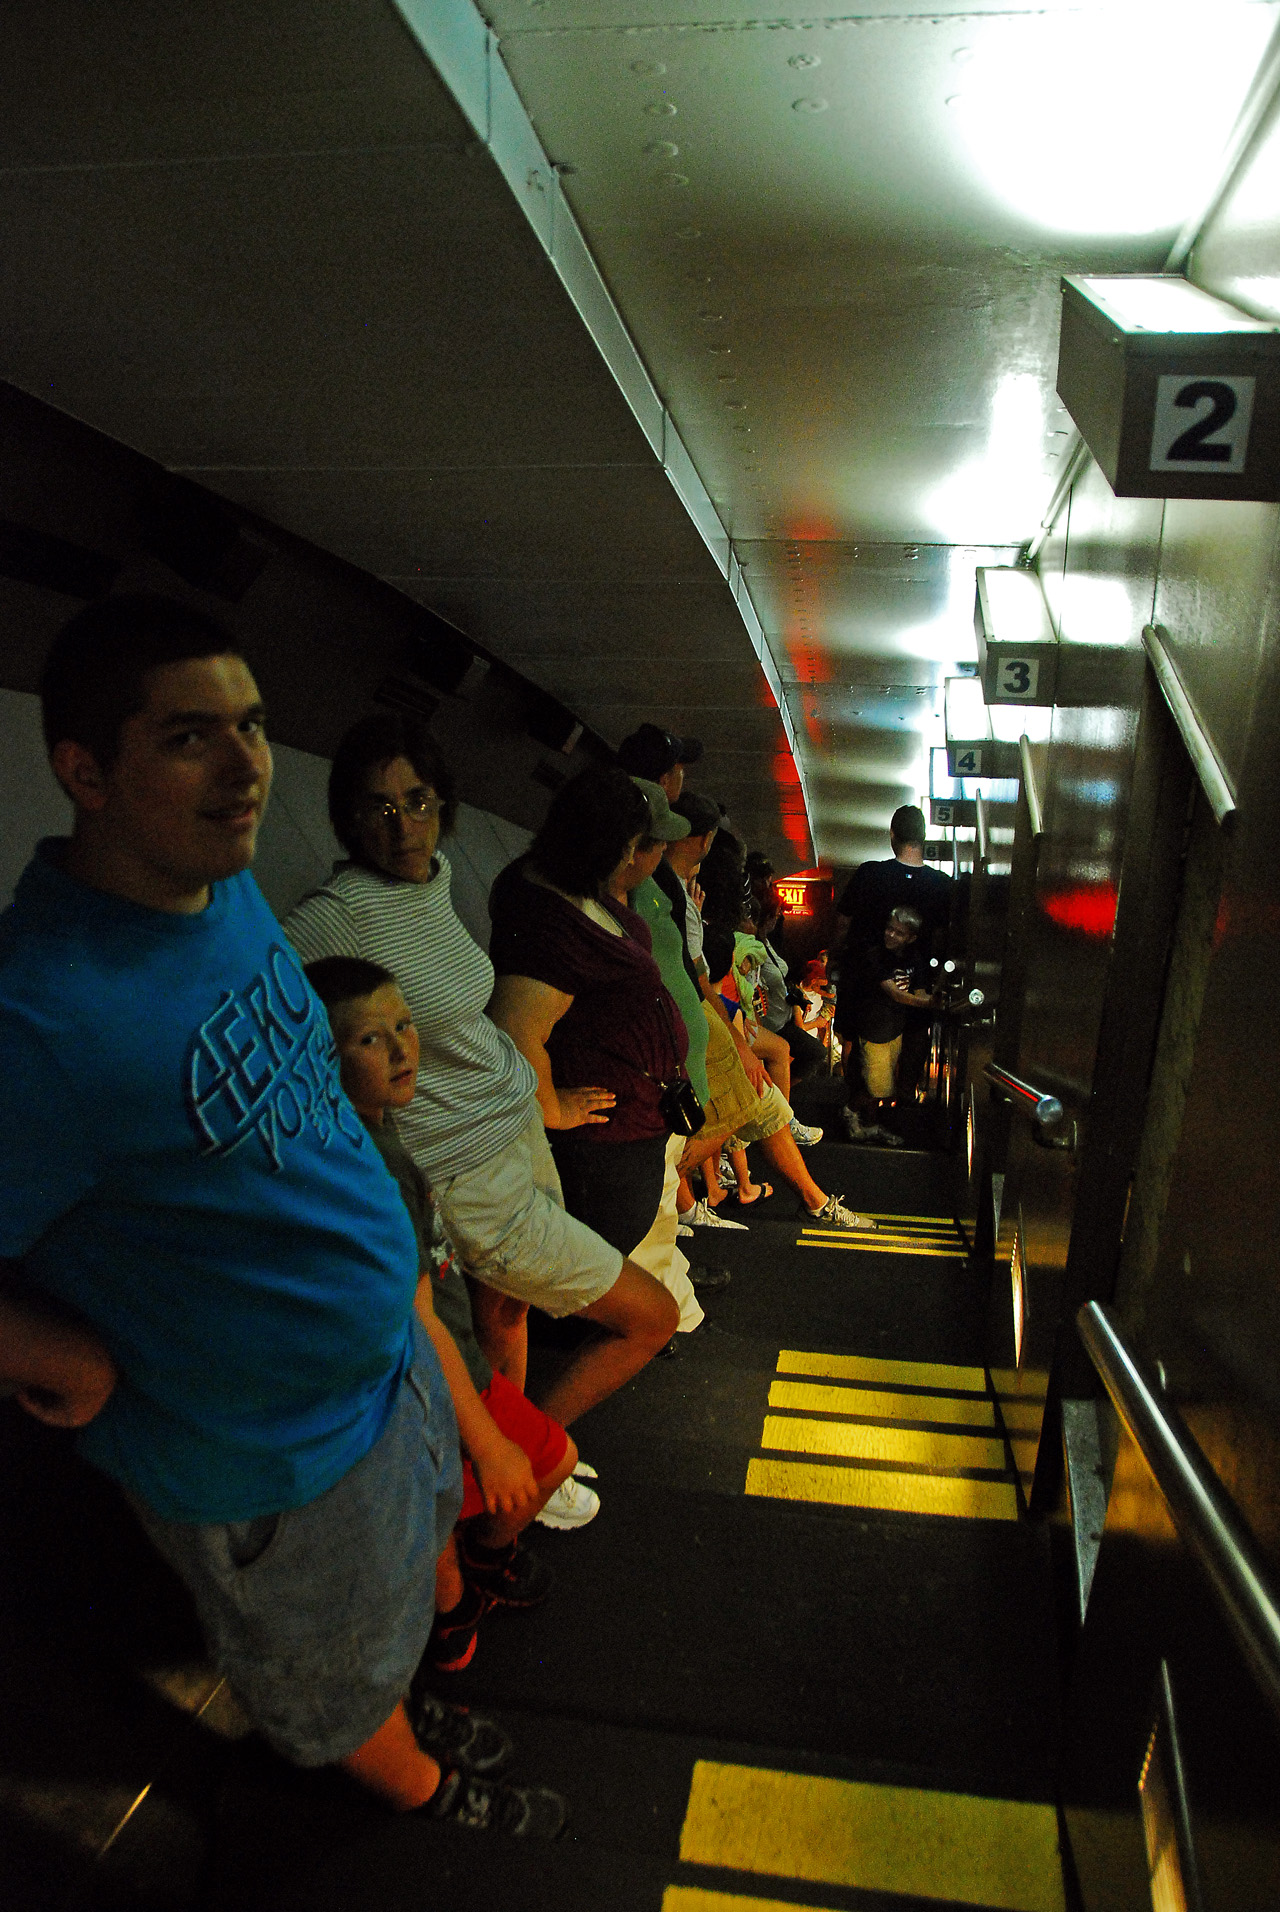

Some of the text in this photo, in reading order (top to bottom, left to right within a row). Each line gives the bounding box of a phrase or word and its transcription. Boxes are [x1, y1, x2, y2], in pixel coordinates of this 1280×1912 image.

[1165, 381, 1238, 462] 2
[1003, 661, 1031, 694] 3
[957, 751, 976, 771] 4
[937, 806, 951, 821] 5
[925, 846, 937, 858] 6
